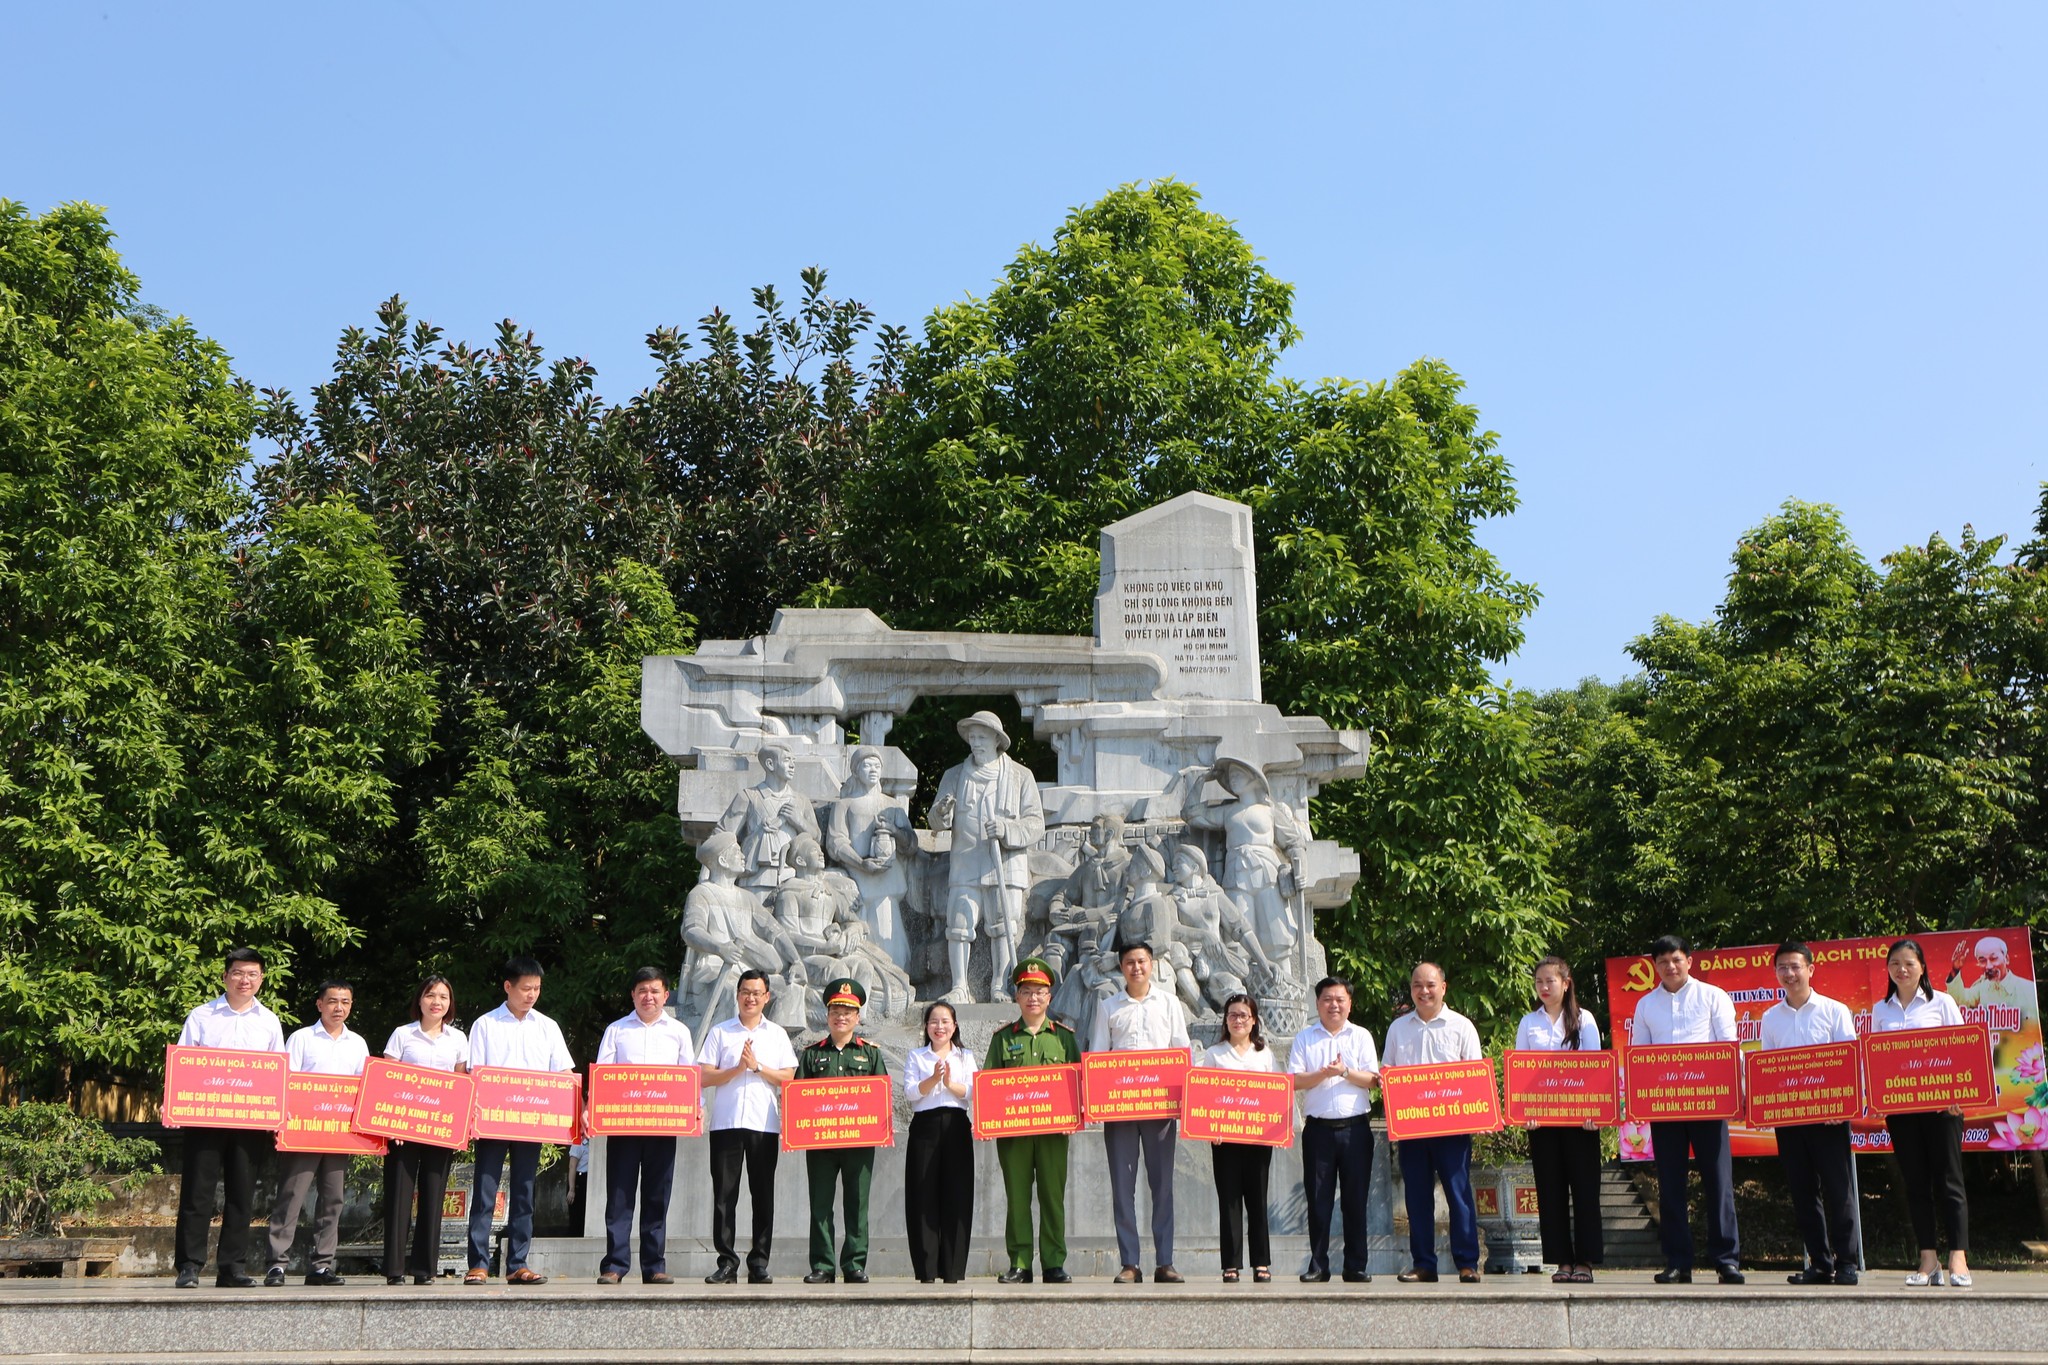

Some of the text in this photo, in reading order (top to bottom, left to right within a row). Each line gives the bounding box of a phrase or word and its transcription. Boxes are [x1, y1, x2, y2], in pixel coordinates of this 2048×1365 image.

[1988, 1005, 2020, 1032] Thông
[180, 1056, 277, 1071] CHI BỘ VĂN HOÁ XÃ HỘI
[386, 1071, 455, 1089] CHI BỘ KINH TẾ
[618, 1072, 628, 1082] BỘ
[657, 1071, 673, 1081] KIỂM
[1006, 1076, 1015, 1086] BỘ
[1017, 1075, 1038, 1083] CÔNG
[1885, 1069, 1972, 1089] ĐỒNG HÀNH SỐ
[816, 1087, 826, 1097] BỘ
[828, 1086, 848, 1094] QUÂN
[851, 1087, 860, 1095] SỰ
[1883, 1087, 1979, 1104] CÙNG NHÂN DÂN
[376, 1102, 454, 1123] CÁN BỘ KINH TẾ SỐ
[1006, 1103, 1052, 1115] XÃ AN TOÀN
[1191, 1106, 1282, 1123] MỖI QUÝ MỘT VIỆC TỐT
[1396, 1099, 1489, 1120] ĐƯỜNG CỜ TỔ QUỐC
[390, 1119, 408, 1130] DÂN
[416, 1123, 431, 1134] SÁT
[434, 1127, 452, 1138] VIỆC
[796, 1115, 877, 1129] LỰC LƯỢNG DÂN QUÂN
[981, 1115, 1077, 1130] TRÊN KHÔNG GIAN MẠNG
[1210, 1122, 1263, 1135] VÌ NHÂN DÂN
[815, 1132, 819, 1140] 3
[840, 1129, 860, 1139] SÀNG
[1966, 1129, 1988, 1142] 2026
